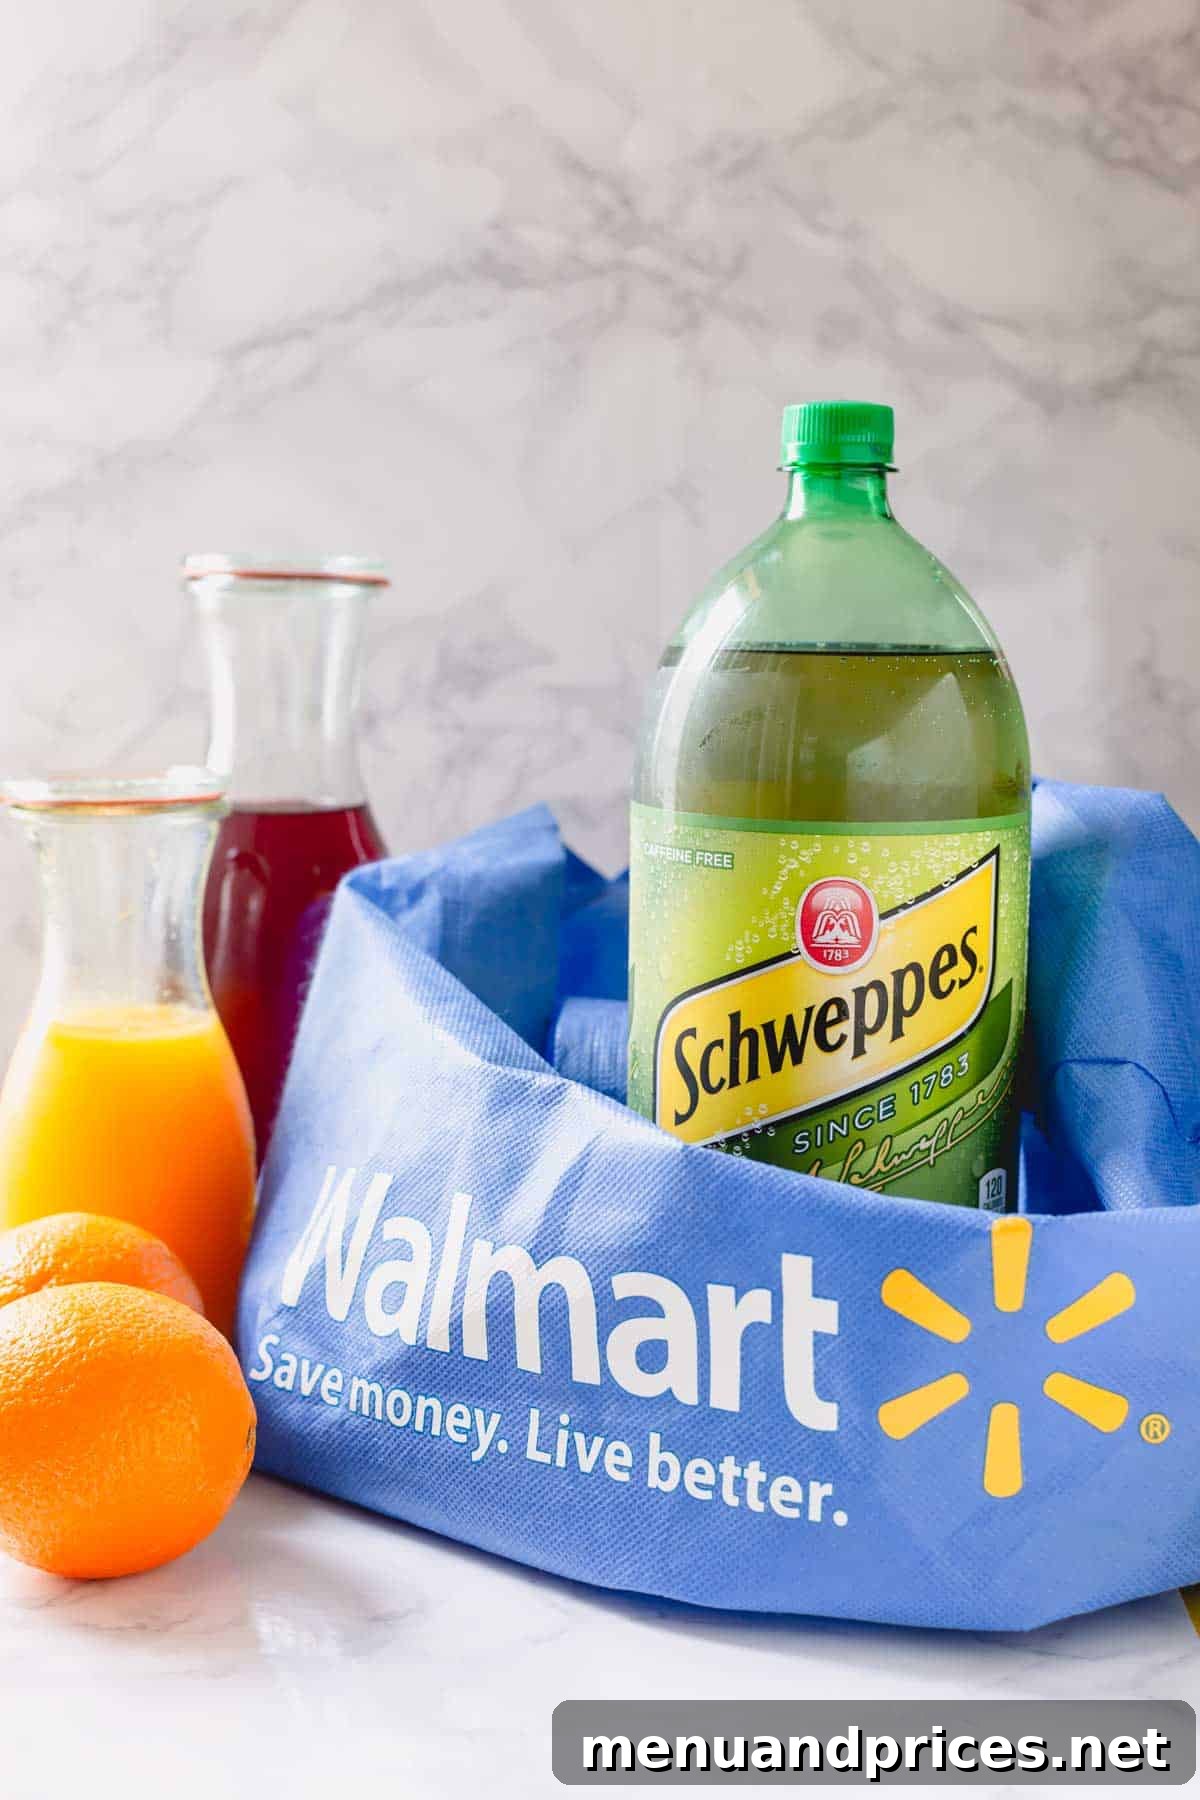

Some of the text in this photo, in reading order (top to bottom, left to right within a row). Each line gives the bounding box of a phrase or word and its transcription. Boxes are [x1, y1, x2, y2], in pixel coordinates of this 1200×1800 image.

[643, 842, 733, 868] CAFFEINE FREE
[823, 949, 849, 961] 1783
[673, 925, 979, 1126] Schweppes
[793, 1052, 970, 1154] SINCE 1783
[985, 1175, 1003, 1200] 120
[280, 1165, 839, 1432] Walmart
[249, 1333, 850, 1527] Save money. Live better.
